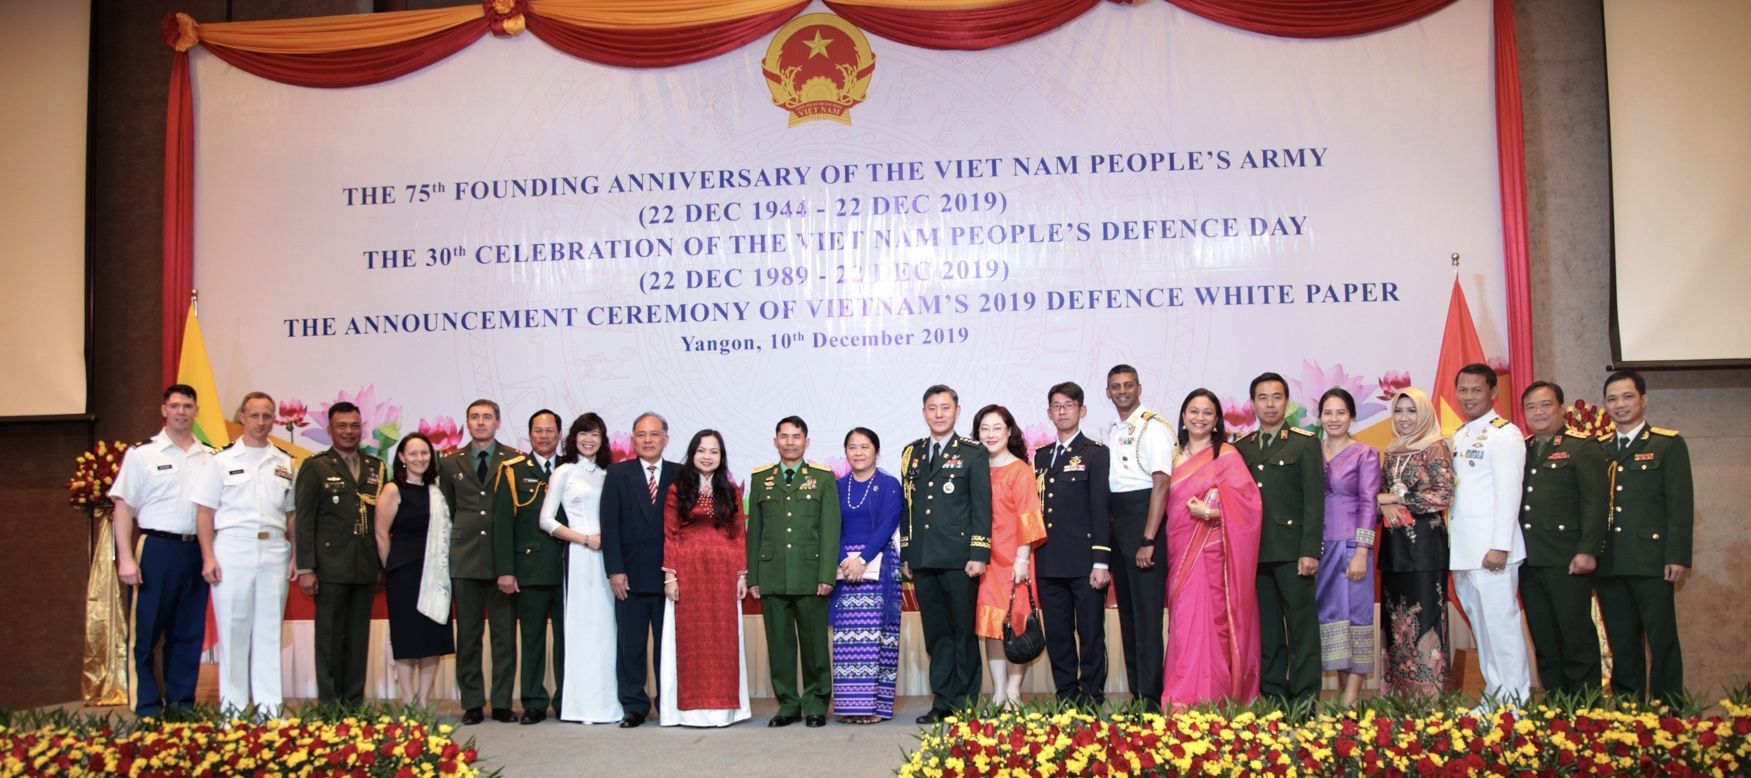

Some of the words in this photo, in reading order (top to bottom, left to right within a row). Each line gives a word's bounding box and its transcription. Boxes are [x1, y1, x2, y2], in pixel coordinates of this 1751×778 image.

[798, 107, 818, 116] VIET
[820, 106, 841, 116] NAM
[343, 186, 395, 205] THE
[406, 182, 445, 203] 75th
[455, 175, 600, 200] FOUNDING
[608, 167, 811, 193] ANNIVERSARY
[821, 165, 857, 184] OF
[866, 162, 924, 182] THE
[935, 159, 1002, 178] VIET
[1013, 156, 1077, 176] NAM
[1091, 151, 1230, 173] PEOPLE'S
[1241, 148, 1327, 168] ARMY
[639, 205, 674, 229] (22
[686, 202, 740, 222] DEC
[753, 200, 807, 220] 1944
[836, 197, 860, 217] 22
[872, 195, 930, 215] DEC
[941, 192, 1007, 214] 2019)
[363, 249, 416, 269] THE
[426, 245, 465, 266] 30th
[475, 238, 673, 264] CELEBRATION
[684, 236, 721, 256] OF
[729, 234, 787, 254] THE
[796, 231, 864, 251] VIET
[875, 228, 938, 248] NAM
[952, 223, 1090, 245] PEOPLE'S
[1103, 218, 1238, 240] DEFENCE
[1249, 216, 1306, 236] DAY
[639, 271, 674, 294] (22
[686, 268, 741, 288] DEC
[755, 266, 808, 286] 1989
[943, 259, 1009, 282] 2019)
[284, 318, 336, 337] THE
[345, 308, 577, 335] ANNOUNCEMENT
[587, 302, 749, 326] CEREMONY
[760, 300, 797, 320] OF
[805, 293, 968, 319] VIETNAM'S
[979, 292, 1036, 312] 2019
[1048, 288, 1183, 311] DEFENCE
[1195, 284, 1294, 306] WHITE
[1307, 283, 1400, 303] PAPER
[681, 336, 761, 355] Yangon,
[771, 331, 805, 349] 10th
[812, 330, 914, 348] December
[923, 327, 969, 344] 2019
